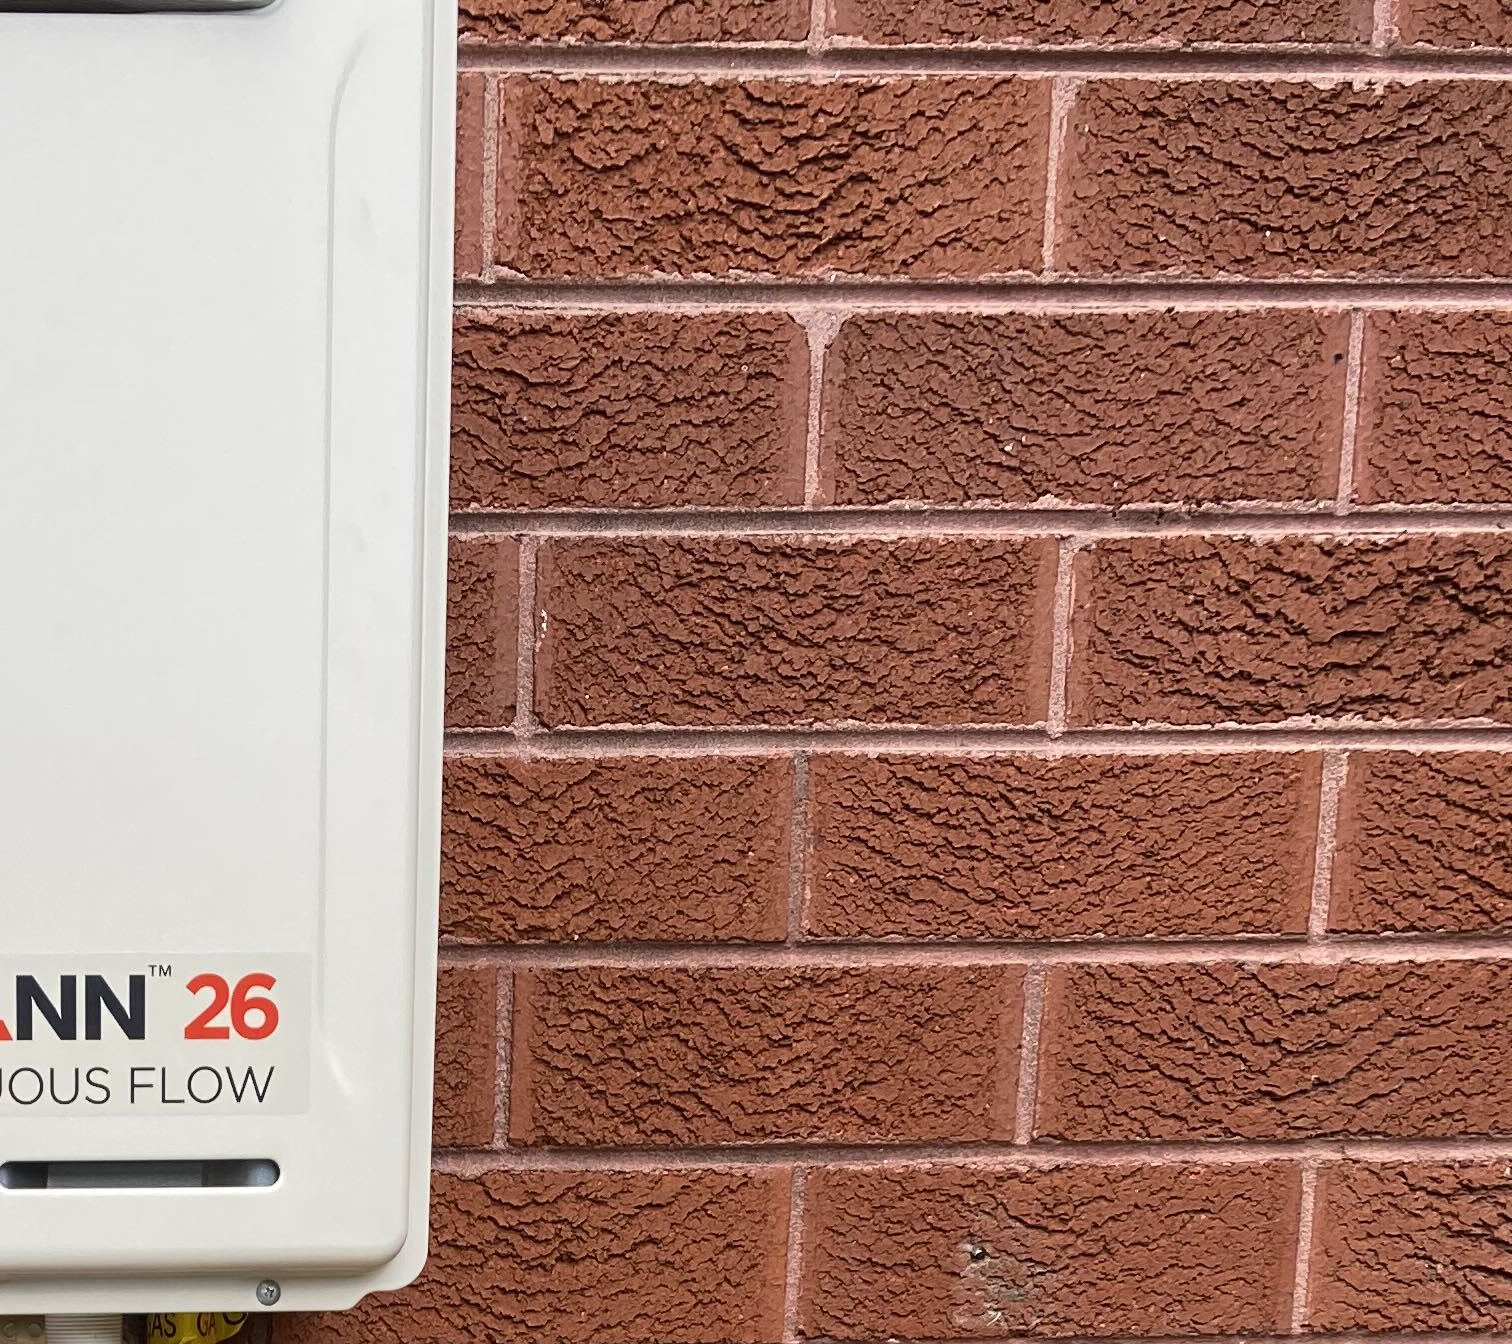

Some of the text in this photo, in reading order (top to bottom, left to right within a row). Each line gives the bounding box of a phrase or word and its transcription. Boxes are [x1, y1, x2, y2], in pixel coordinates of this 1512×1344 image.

[184, 972, 279, 1041] 26
[130, 1065, 276, 1104] FLOW
[151, 1312, 177, 1338] AS
